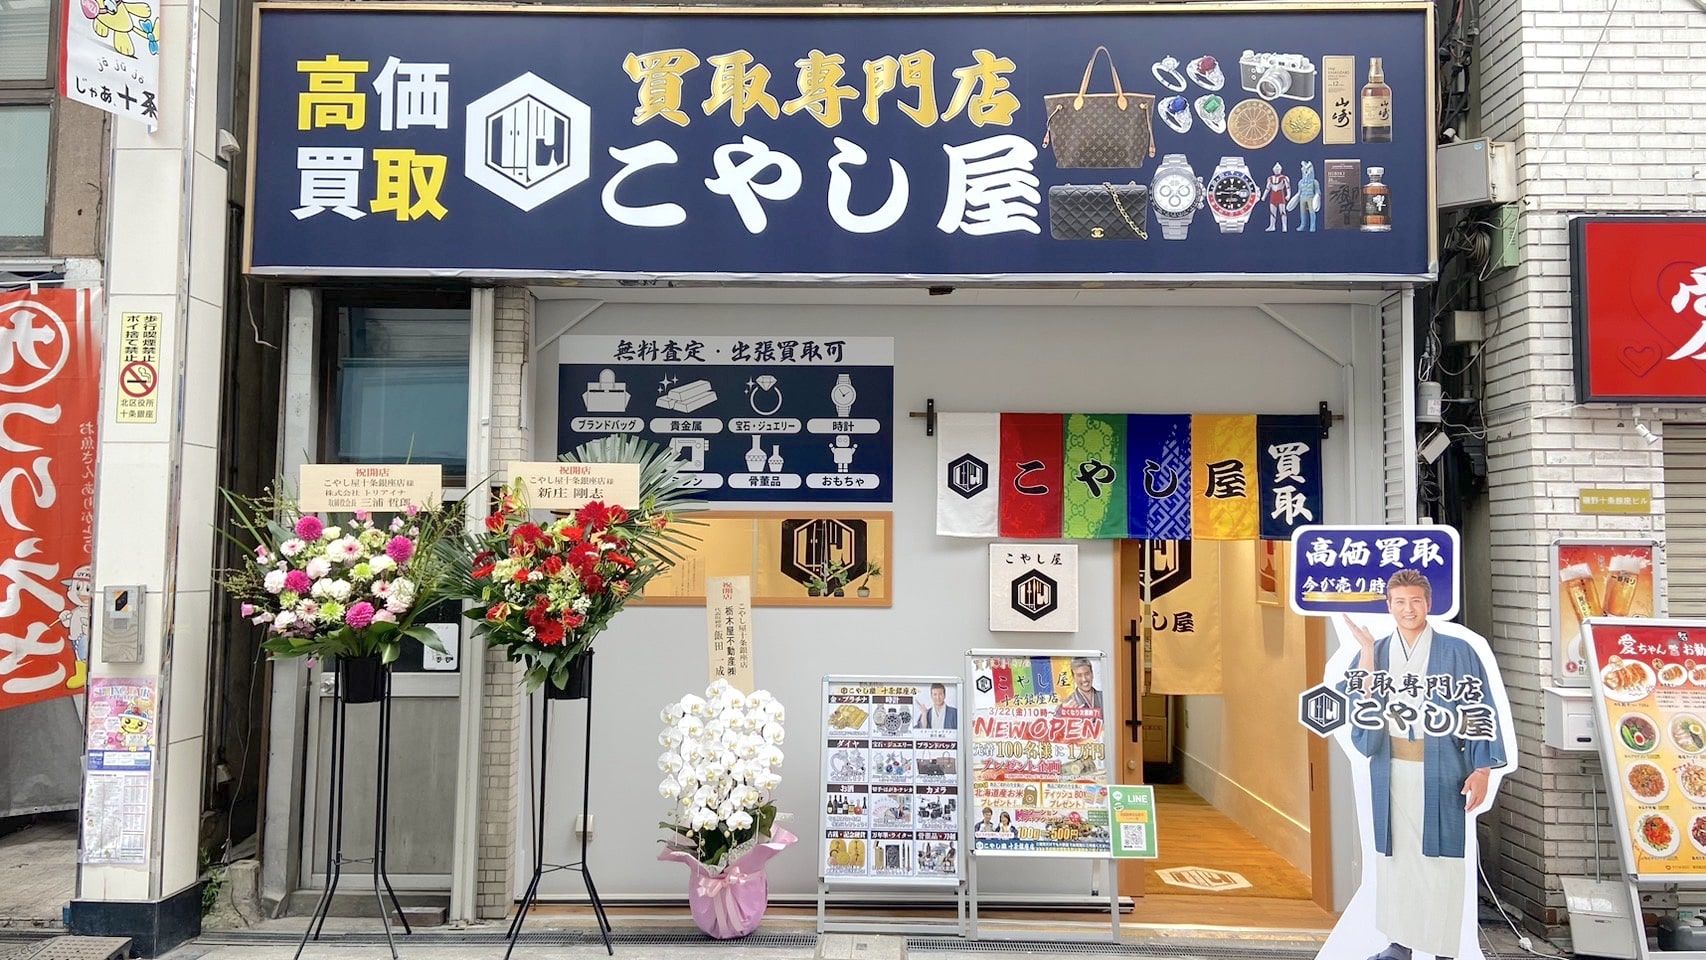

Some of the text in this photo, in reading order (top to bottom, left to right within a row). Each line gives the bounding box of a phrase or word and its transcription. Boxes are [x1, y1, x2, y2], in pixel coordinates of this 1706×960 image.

[296, 54, 449, 132] 高価
[622, 48, 1021, 128] 買取専門店
[290, 147, 449, 222] 買取
[600, 134, 1041, 236] こやし屋
[142, 315, 158, 362] 歩行喫煙禁止
[614, 339, 846, 363] 無料査定・出張買取可
[121, 399, 154, 407] 北区役所
[120, 410, 154, 419] 十条銀座
[578, 420, 636, 431] ブランドバッグ
[670, 420, 703, 432] 貴金属
[736, 421, 795, 431] 宝石・ジュエリー
[832, 420, 854, 432] 時計
[355, 468, 390, 477] 祝開店
[559, 466, 591, 475] 祝開店
[748, 476, 781, 487] 骨董品
[822, 476, 865, 486] おもちゃ
[1014, 458, 1247, 499] こやし屋
[1268, 441, 1313, 526] 買取
[325, 489, 361, 497] 株式会社
[538, 487, 604, 499] 新庄 剛志
[1005, 552, 1063, 566] こやし屋
[1305, 537, 1445, 569] 高価買取
[1302, 577, 1387, 594] 今が売り時
[1618, 633, 1667, 655] 愛ちゃん
[998, 671, 1071, 691] こやし屋
[1344, 669, 1484, 703] 買取専門店
[885, 696, 899, 704] 時計
[1353, 701, 1495, 738] こやし屋
[974, 717, 1103, 740] NEW OPEN
[836, 740, 860, 748] ダイヤ
[916, 741, 956, 750] ブランドバッグ
[840, 785, 855, 793] お酒
[926, 786, 947, 795] カメラ
[975, 789, 1024, 798] 北海道産お米
[1127, 795, 1148, 803] LINE
